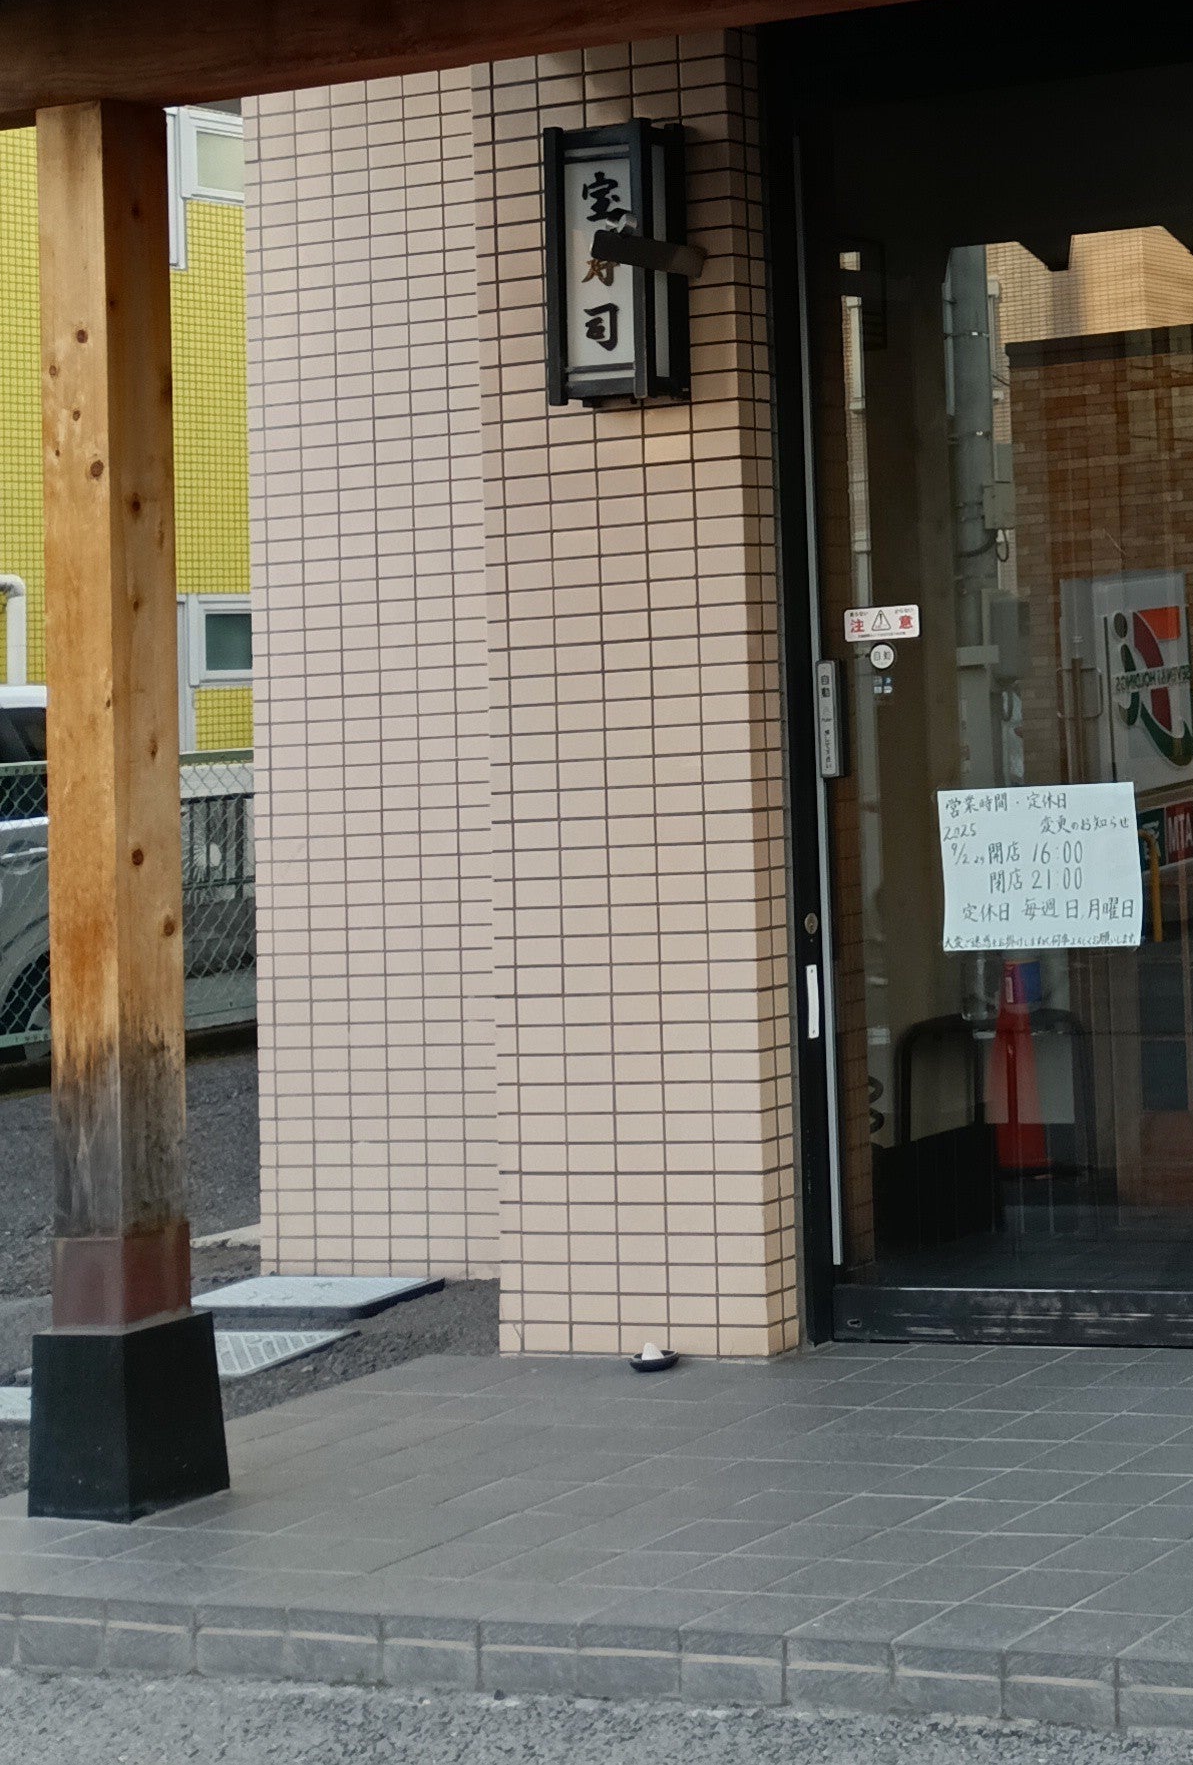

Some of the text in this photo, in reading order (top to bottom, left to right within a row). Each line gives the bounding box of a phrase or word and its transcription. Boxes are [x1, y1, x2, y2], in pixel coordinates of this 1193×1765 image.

[943, 822, 977, 842] 2025
[1040, 815, 1130, 834] 変更のお知らせ
[1032, 840, 1083, 865] 16:00
[1031, 866, 1083, 891] 21:00
